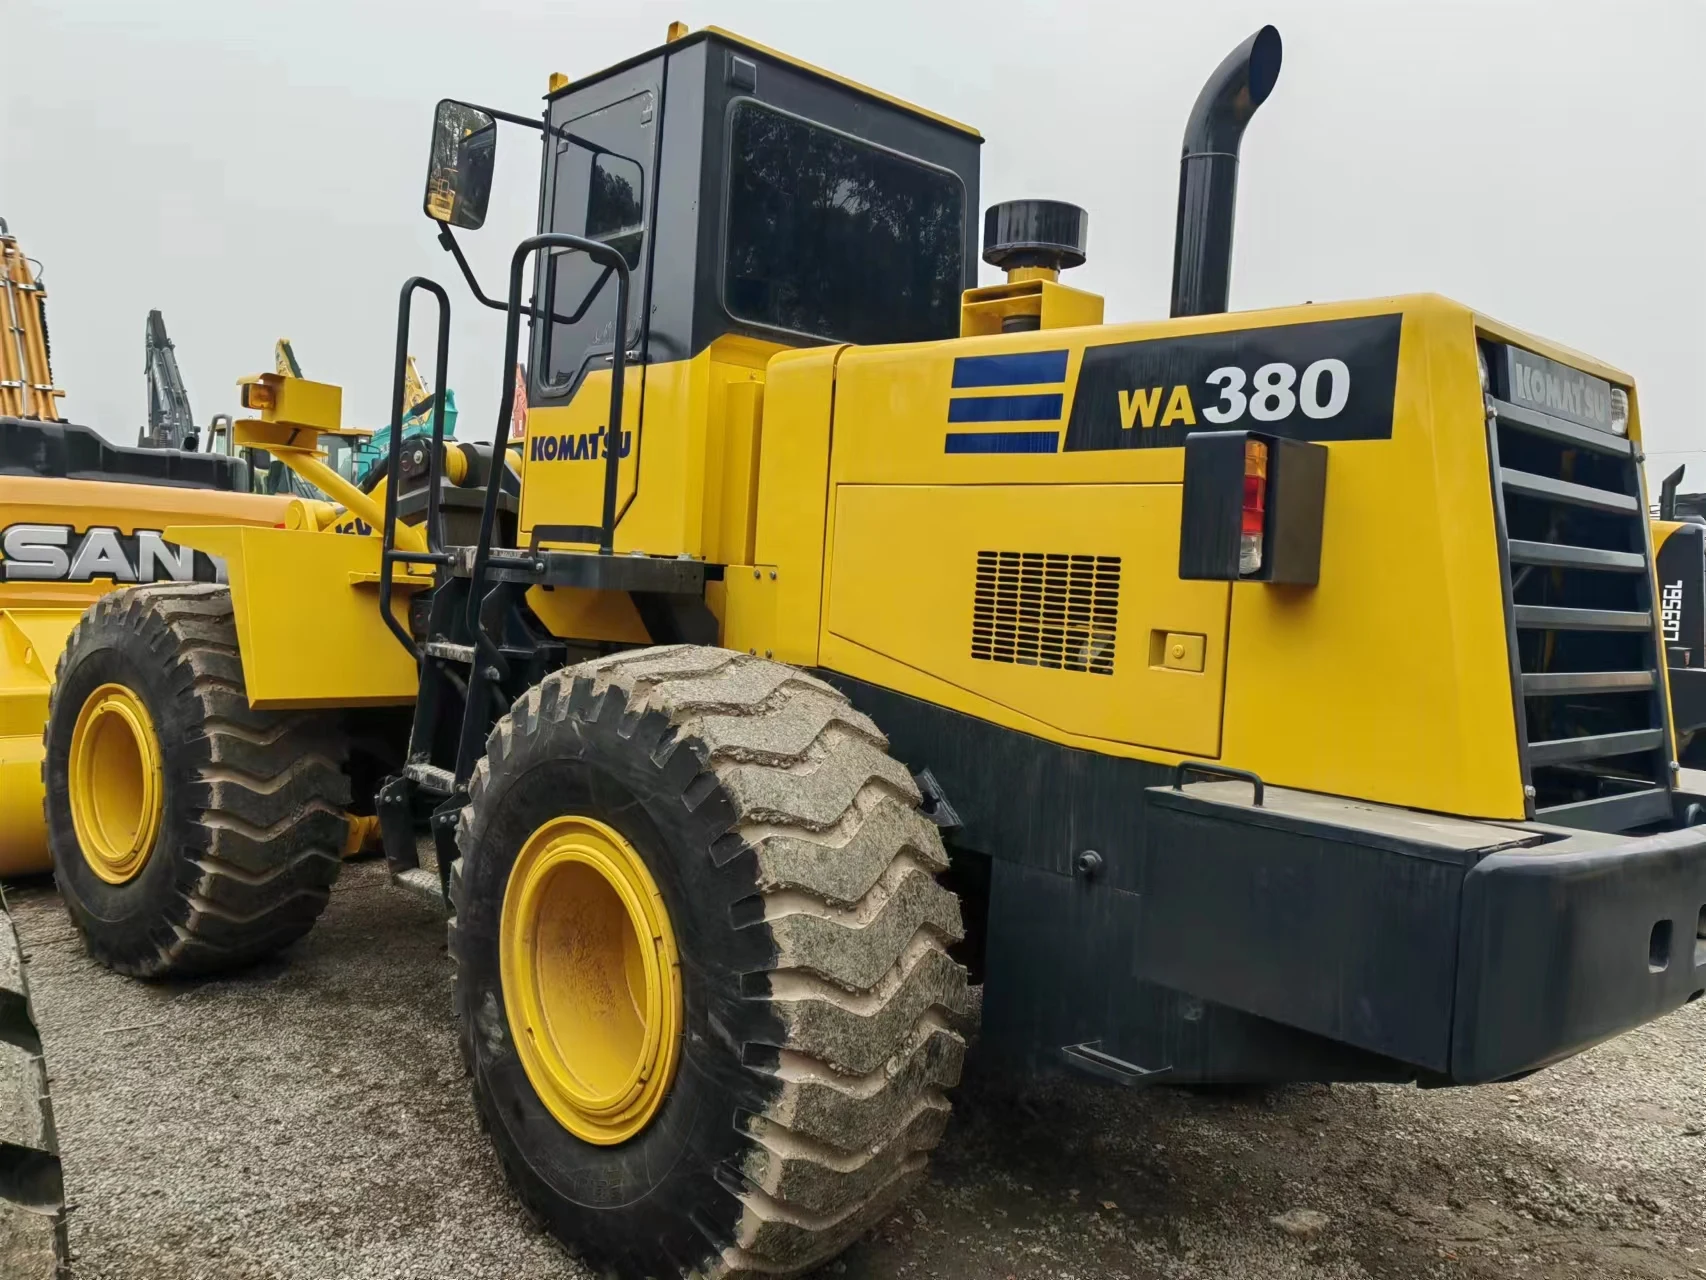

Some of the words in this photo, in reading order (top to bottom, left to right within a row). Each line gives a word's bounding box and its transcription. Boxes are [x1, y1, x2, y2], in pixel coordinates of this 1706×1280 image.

[1118, 385, 1197, 429] WA
[1202, 358, 1351, 424] 380
[1515, 362, 1606, 423] KOMATSU
[1661, 579, 1683, 642] LG956L
